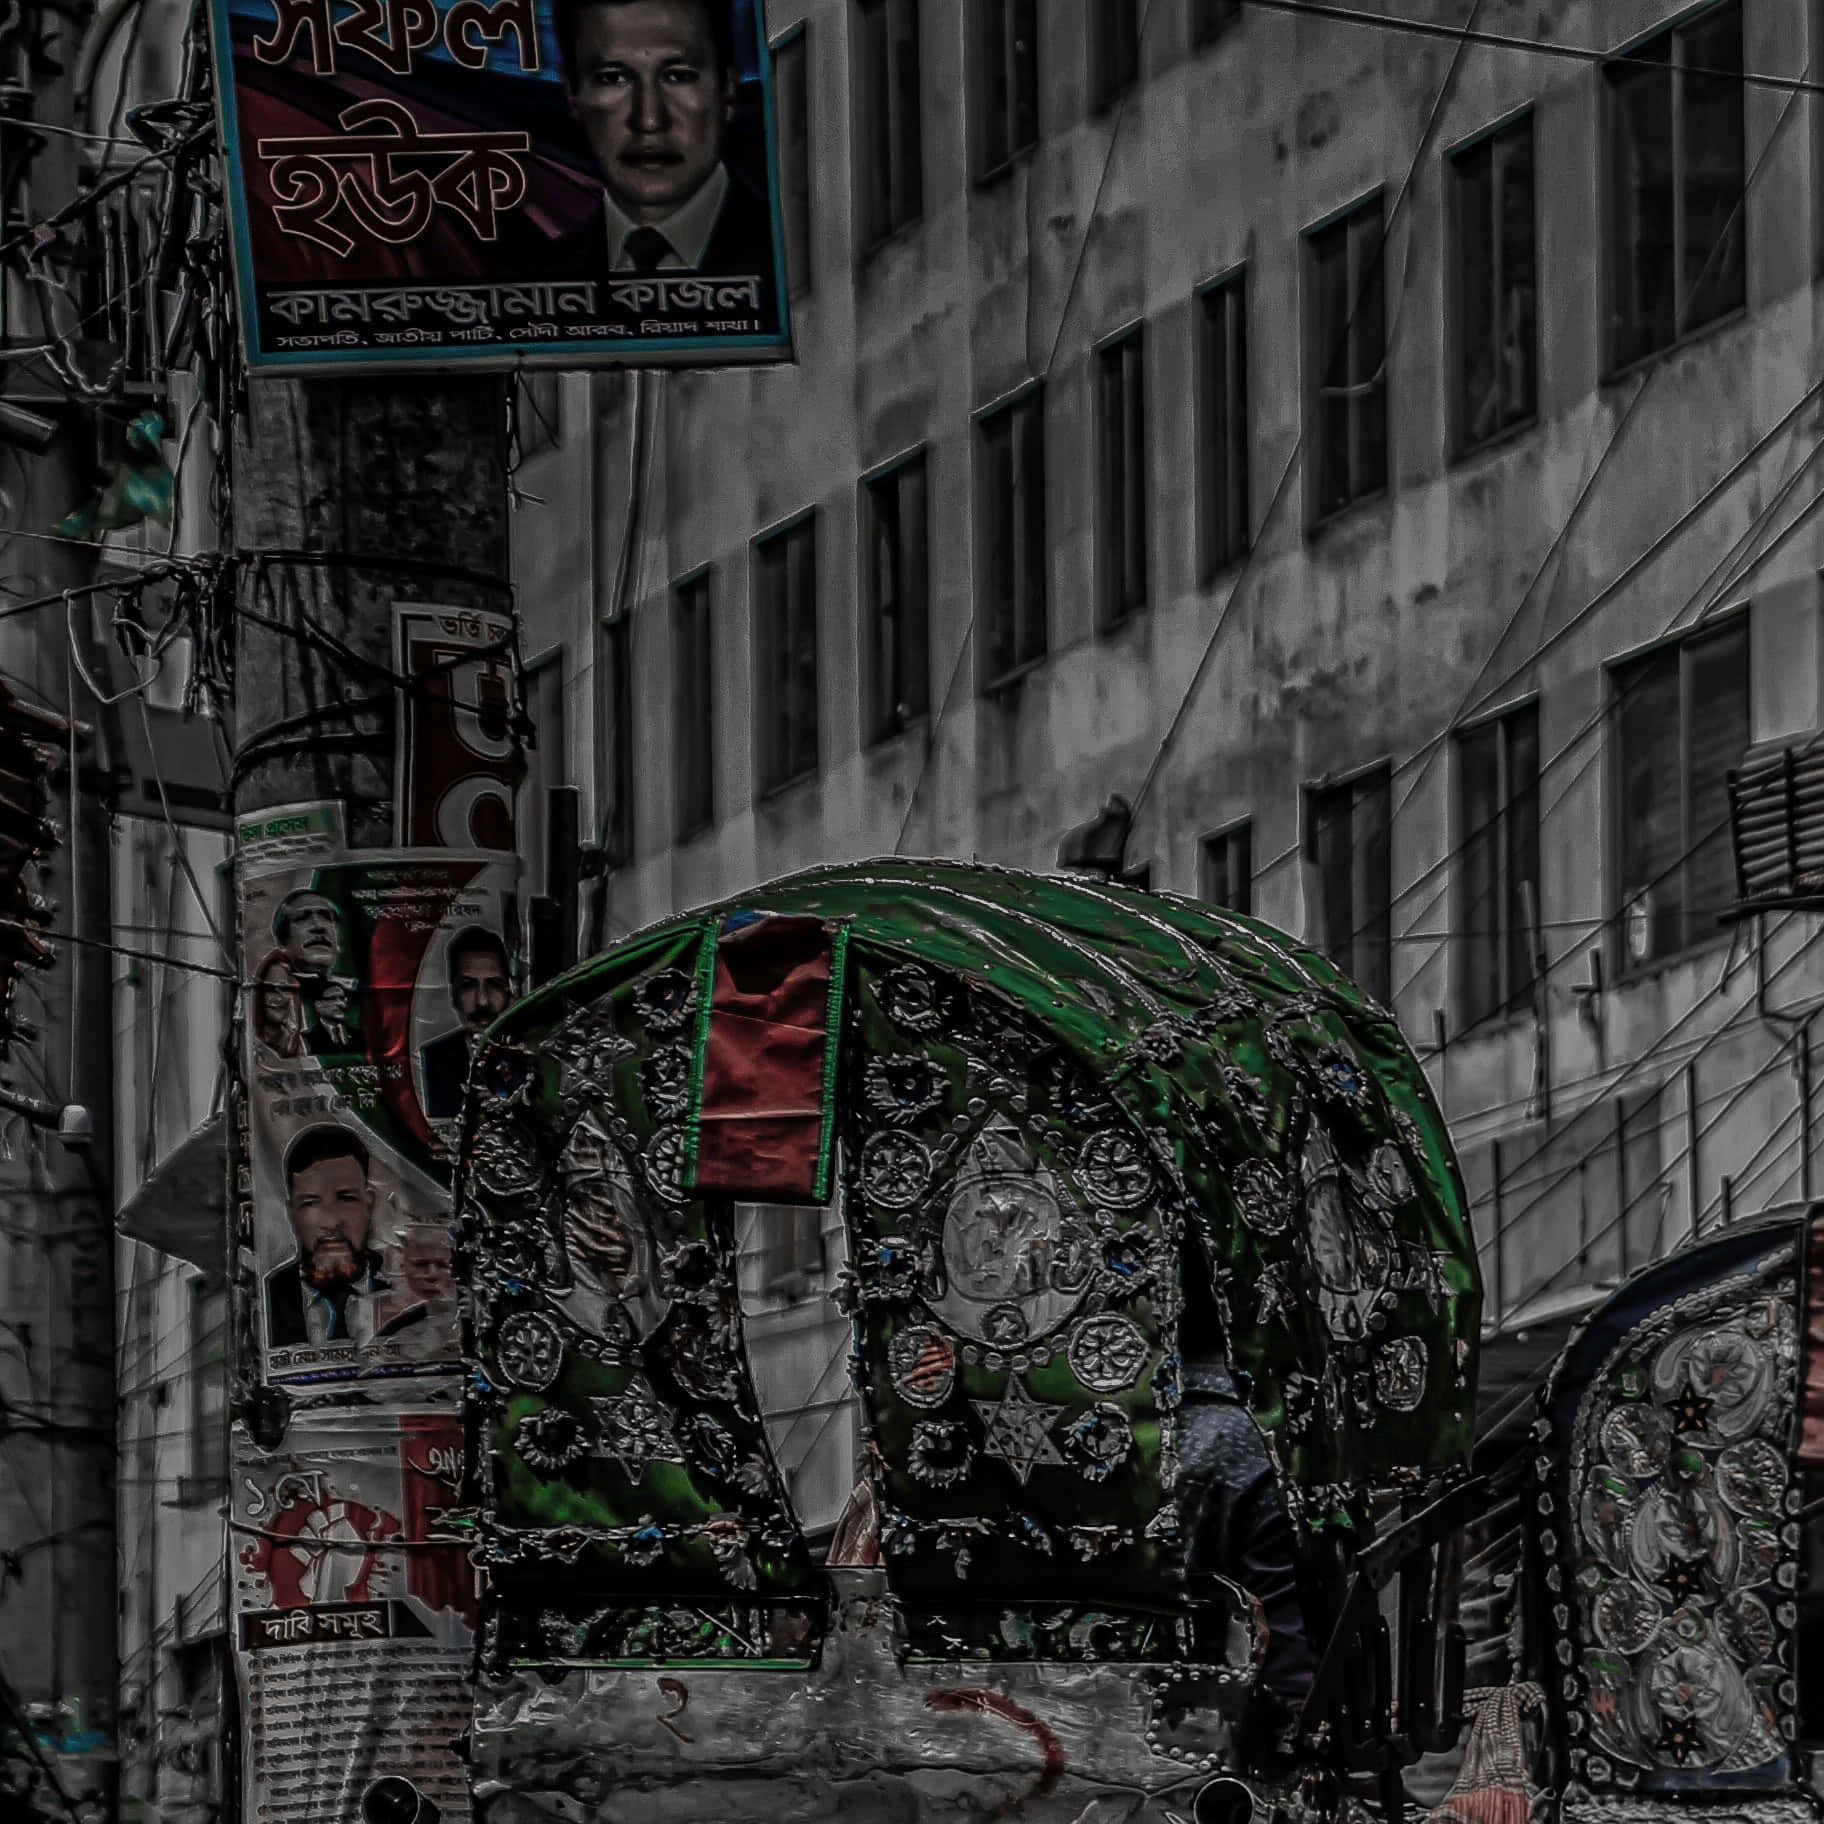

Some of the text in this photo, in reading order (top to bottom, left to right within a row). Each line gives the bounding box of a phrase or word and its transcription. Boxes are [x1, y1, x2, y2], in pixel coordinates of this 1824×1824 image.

[252, 0, 540, 76] সফল
[257, 99, 532, 259] হউক
[267, 274, 761, 325] কামরুজ্জামান কাজল
[438, 611, 482, 640] ভর্তি
[261, 1609, 385, 1641] দাবি সমূহ
